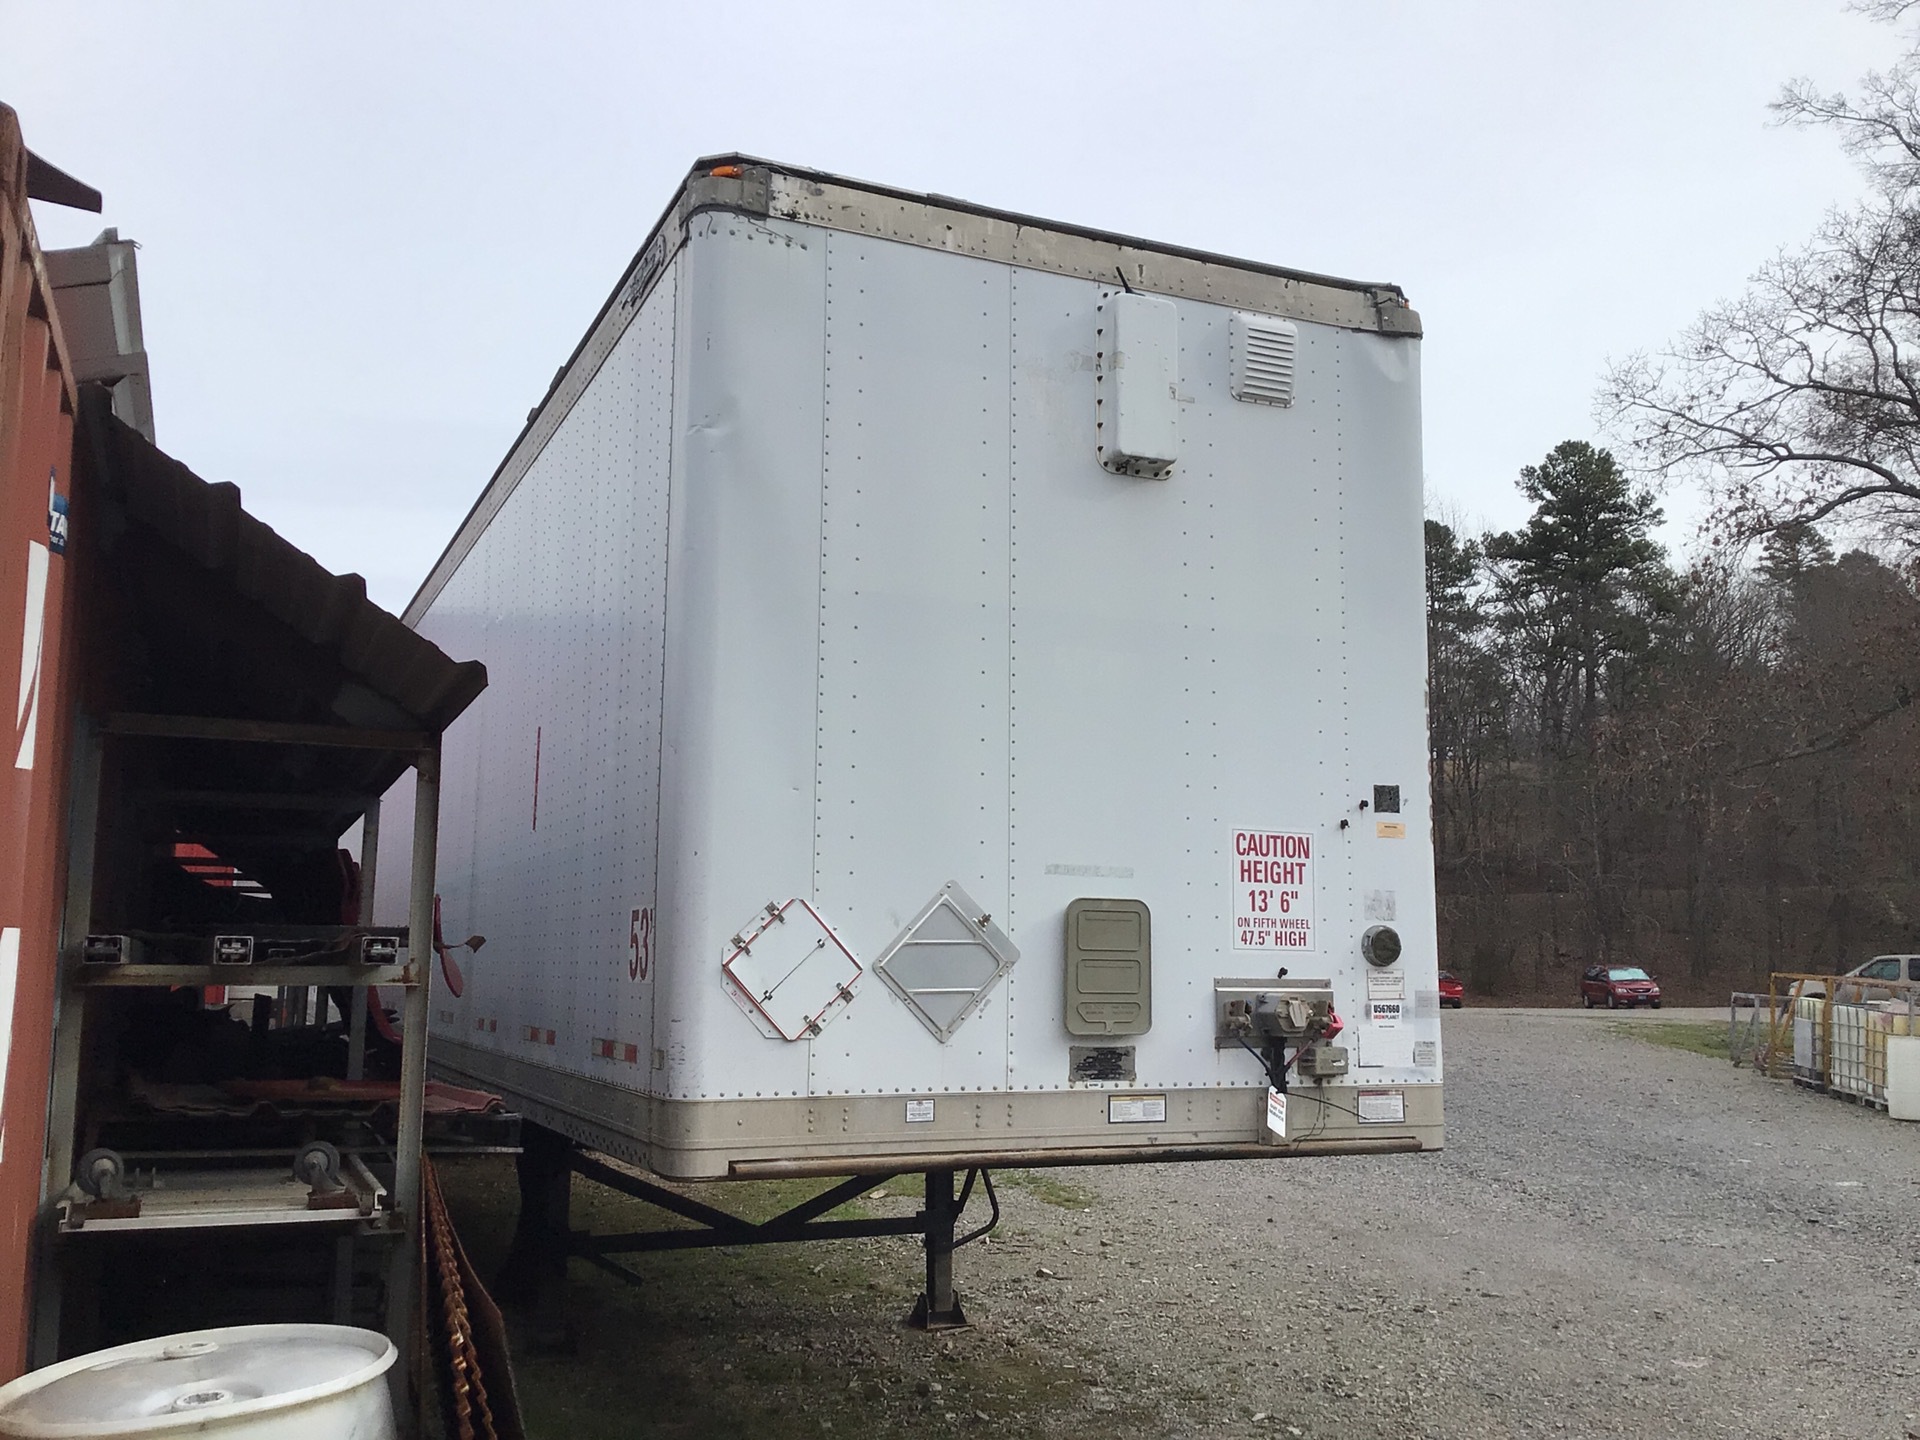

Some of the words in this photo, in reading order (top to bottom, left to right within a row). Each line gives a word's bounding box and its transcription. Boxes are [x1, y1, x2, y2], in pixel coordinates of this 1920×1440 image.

[1236, 833, 1310, 859] CAUTION
[1240, 860, 1306, 885] HEIGHT
[1248, 889, 1273, 912] 13'
[1280, 891, 1298, 913] 6"
[1237, 917, 1250, 928] ON
[1253, 918, 1277, 928] FIFTH
[1279, 918, 1311, 930] WHEEL
[1241, 930, 1270, 945] 47.5"
[1275, 931, 1307, 947] HIGH
